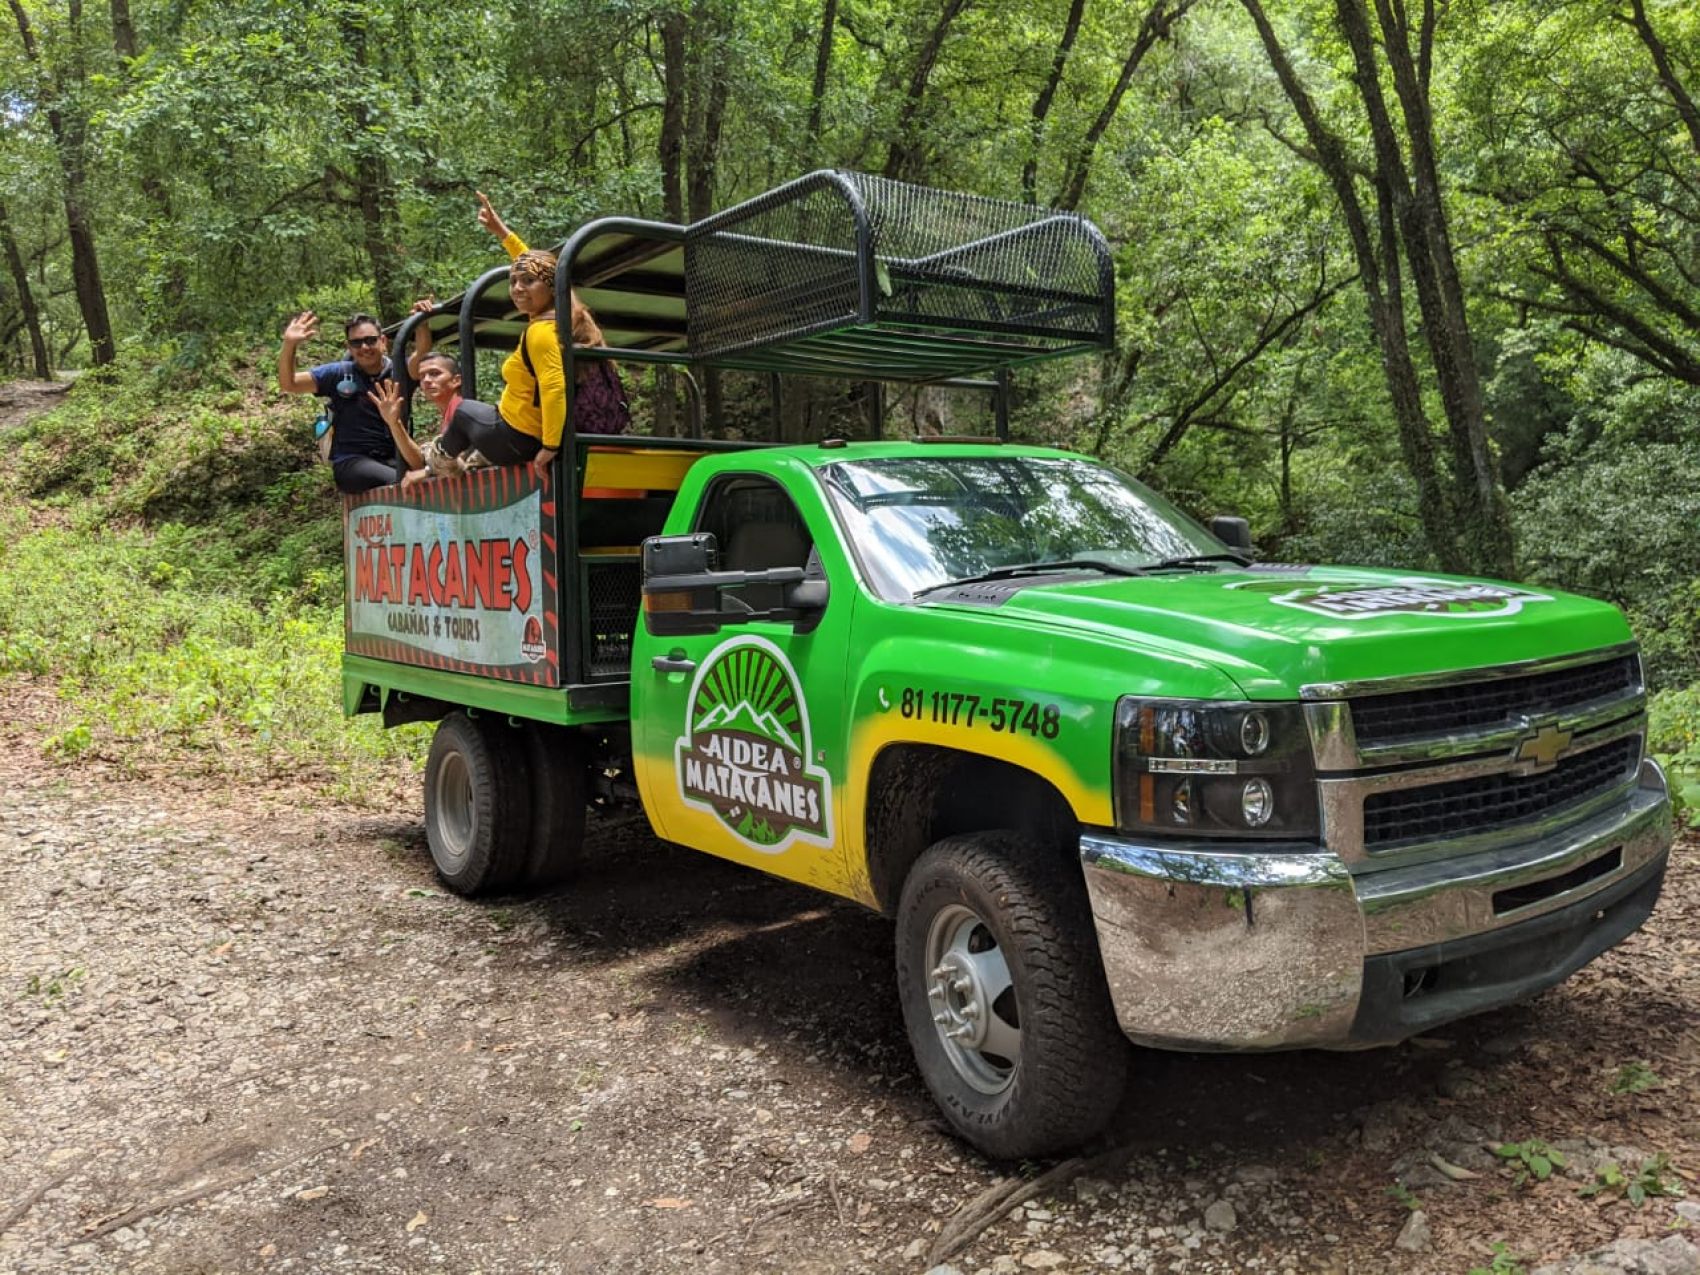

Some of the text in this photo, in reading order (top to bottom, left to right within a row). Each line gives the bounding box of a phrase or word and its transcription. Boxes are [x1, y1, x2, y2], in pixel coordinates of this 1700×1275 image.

[355, 537, 532, 614] MATACANES
[388, 607, 480, 642] CABAÑAS & TOURS
[901, 688, 1060, 739] 81 1177-5748
[686, 758, 819, 823] MATACANES
